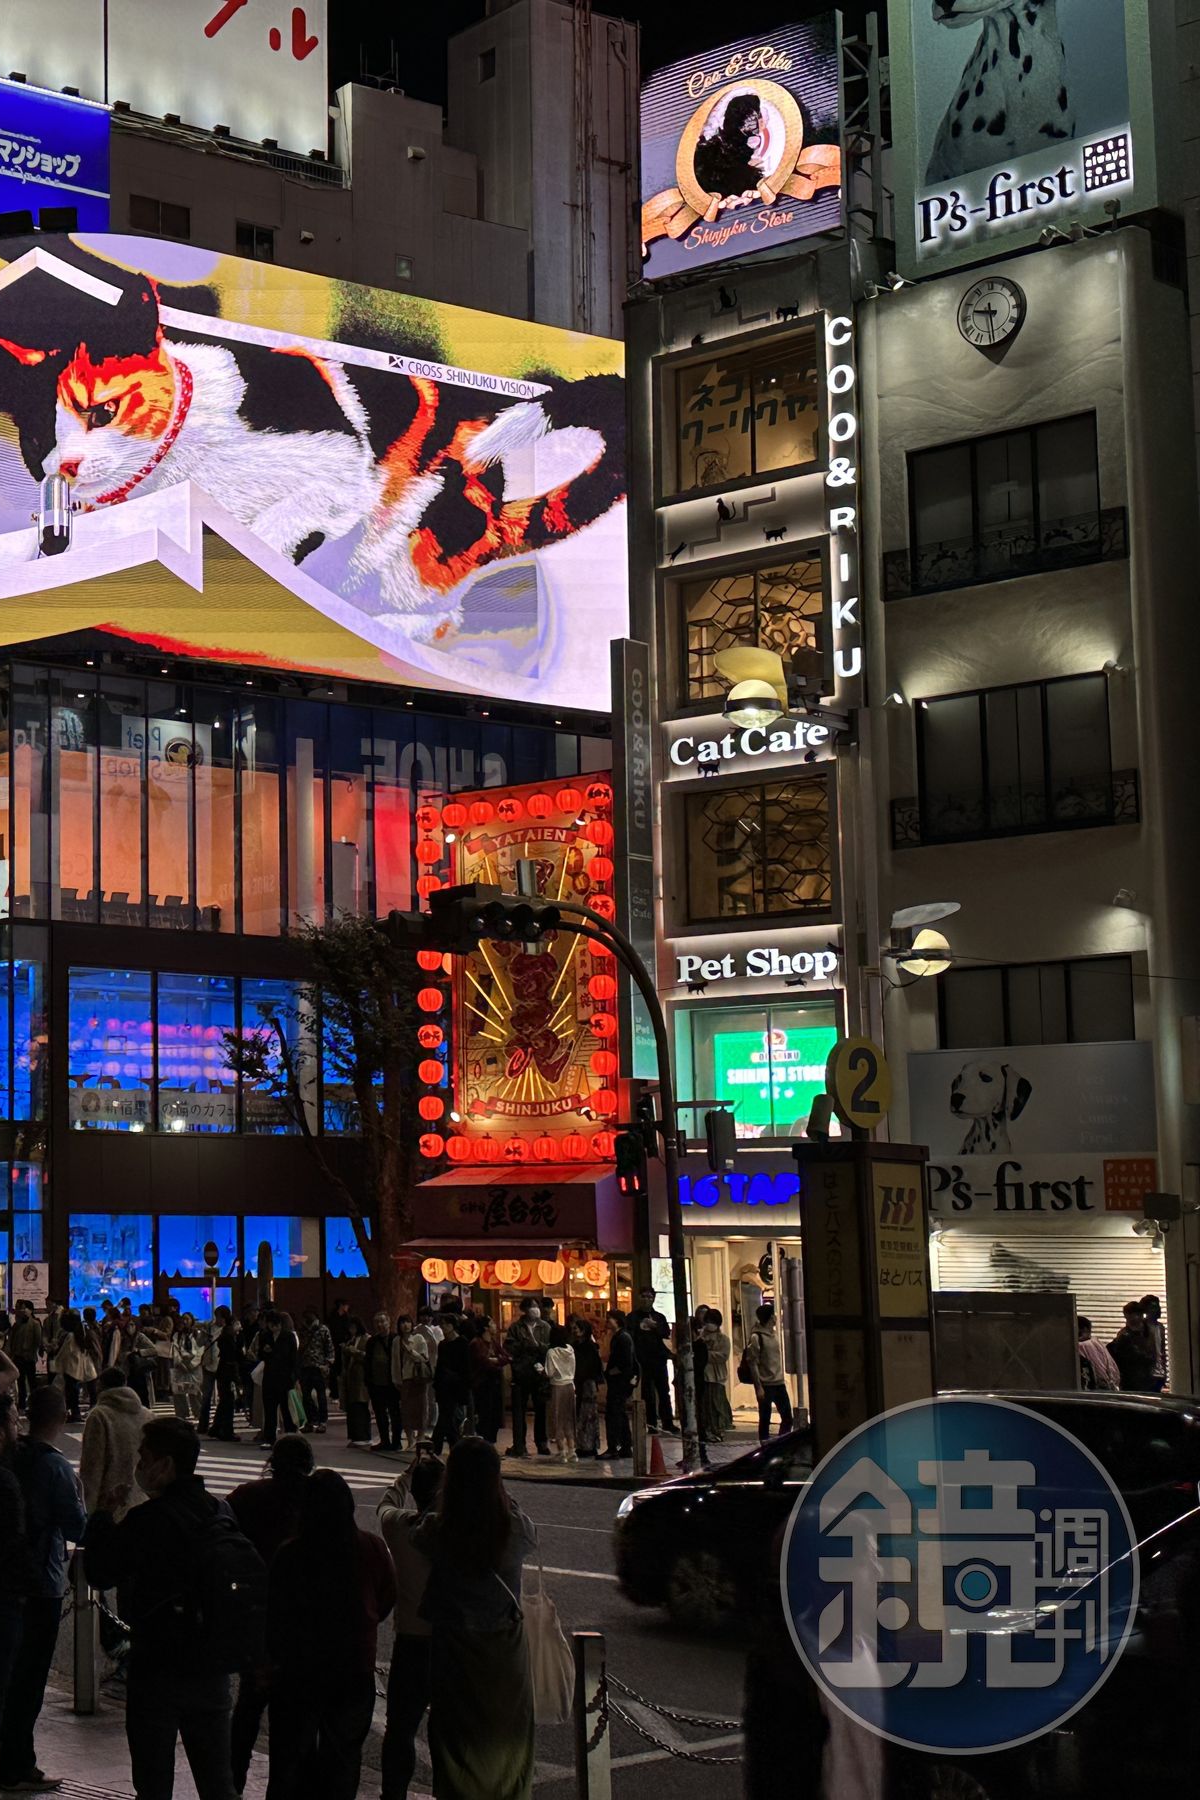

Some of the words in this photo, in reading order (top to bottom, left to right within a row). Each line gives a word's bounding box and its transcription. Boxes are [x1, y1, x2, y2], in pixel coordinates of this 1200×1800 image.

[725, 53, 743, 77] &
[746, 46, 793, 71] Riku
[408, 360, 443, 379] CROSS
[446, 368, 497, 390] SHINJUKU
[500, 379, 535, 397] VISION
[670, 733, 737, 766] Cat
[492, 829, 567, 847] YATAIEN
[676, 953, 737, 983] Pet
[746, 948, 838, 981] Shop
[848, 1047, 881, 1114] 2
[495, 1098, 573, 1116] SHINJUKU
[879, 1268, 923, 1286] はとバス
